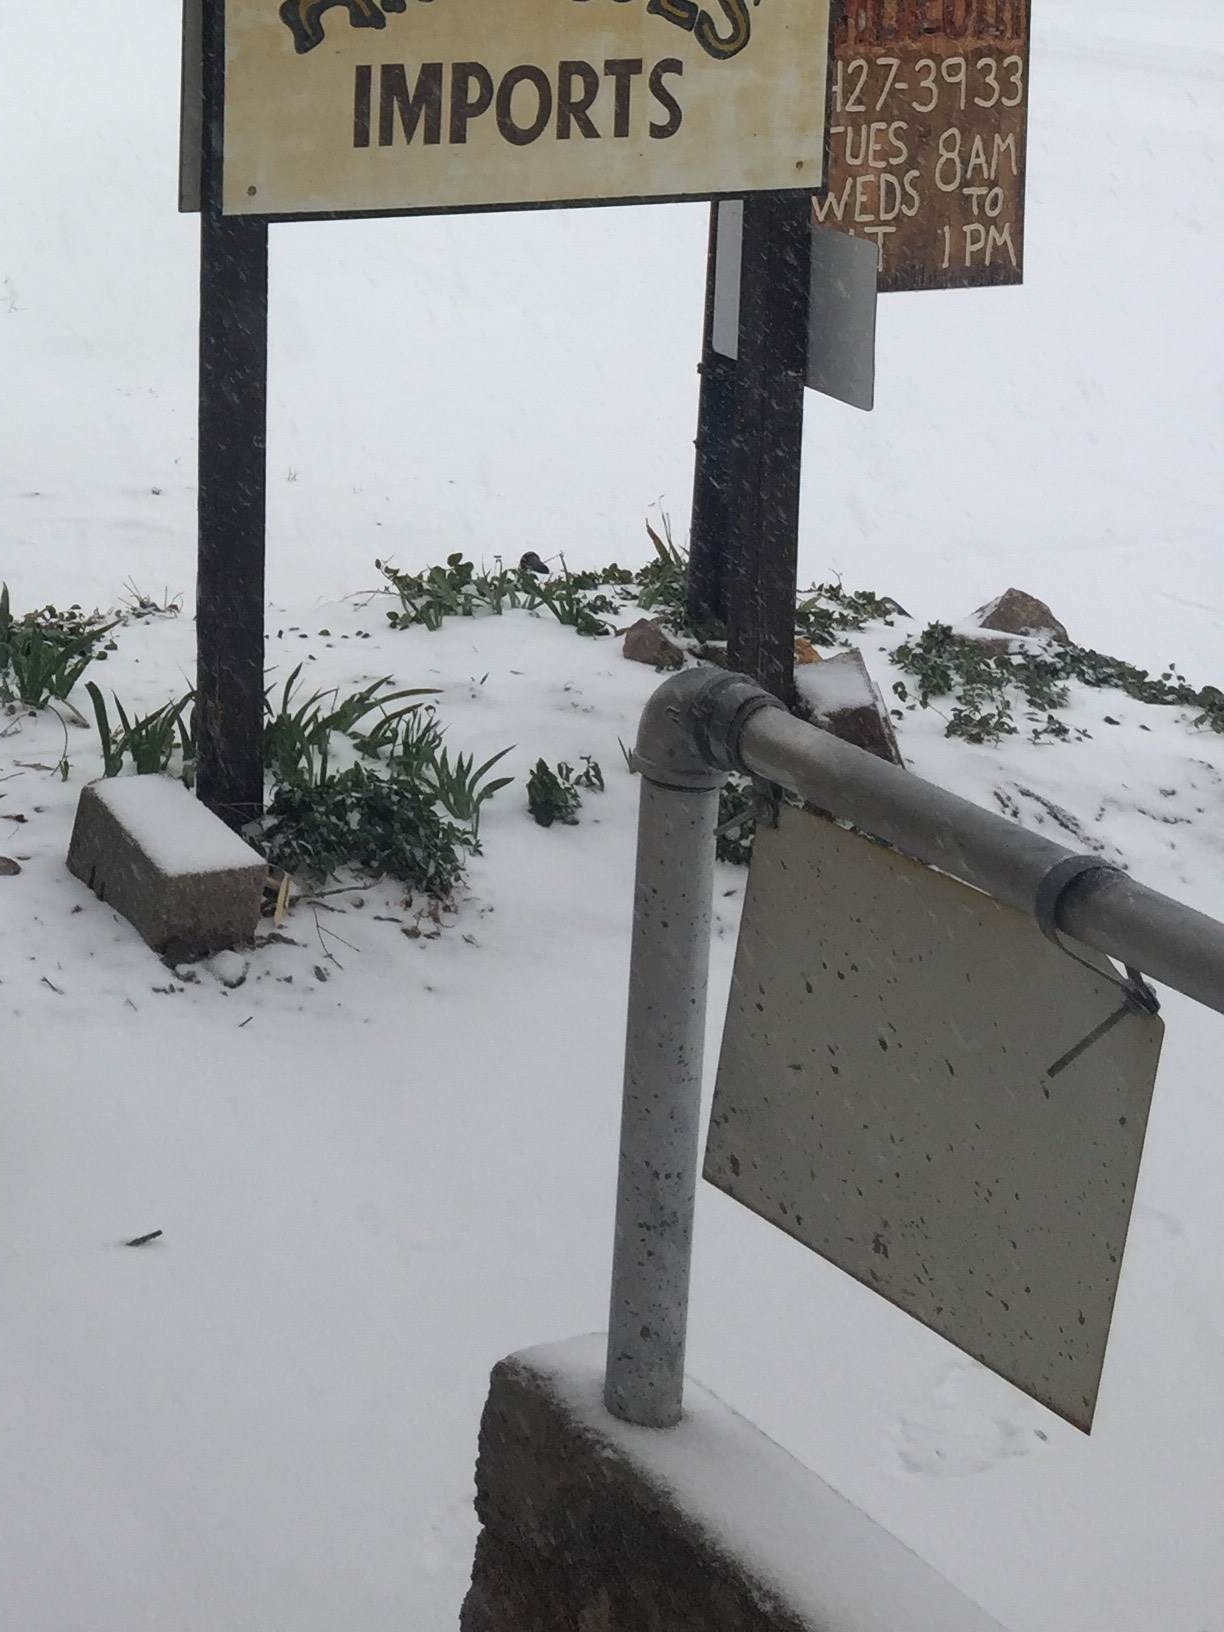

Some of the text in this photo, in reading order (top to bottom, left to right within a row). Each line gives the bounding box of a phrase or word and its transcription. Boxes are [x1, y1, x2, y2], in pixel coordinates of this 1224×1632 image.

[353, 58, 684, 148] IMPORTS
[811, 169, 1005, 222] WEDS TO
